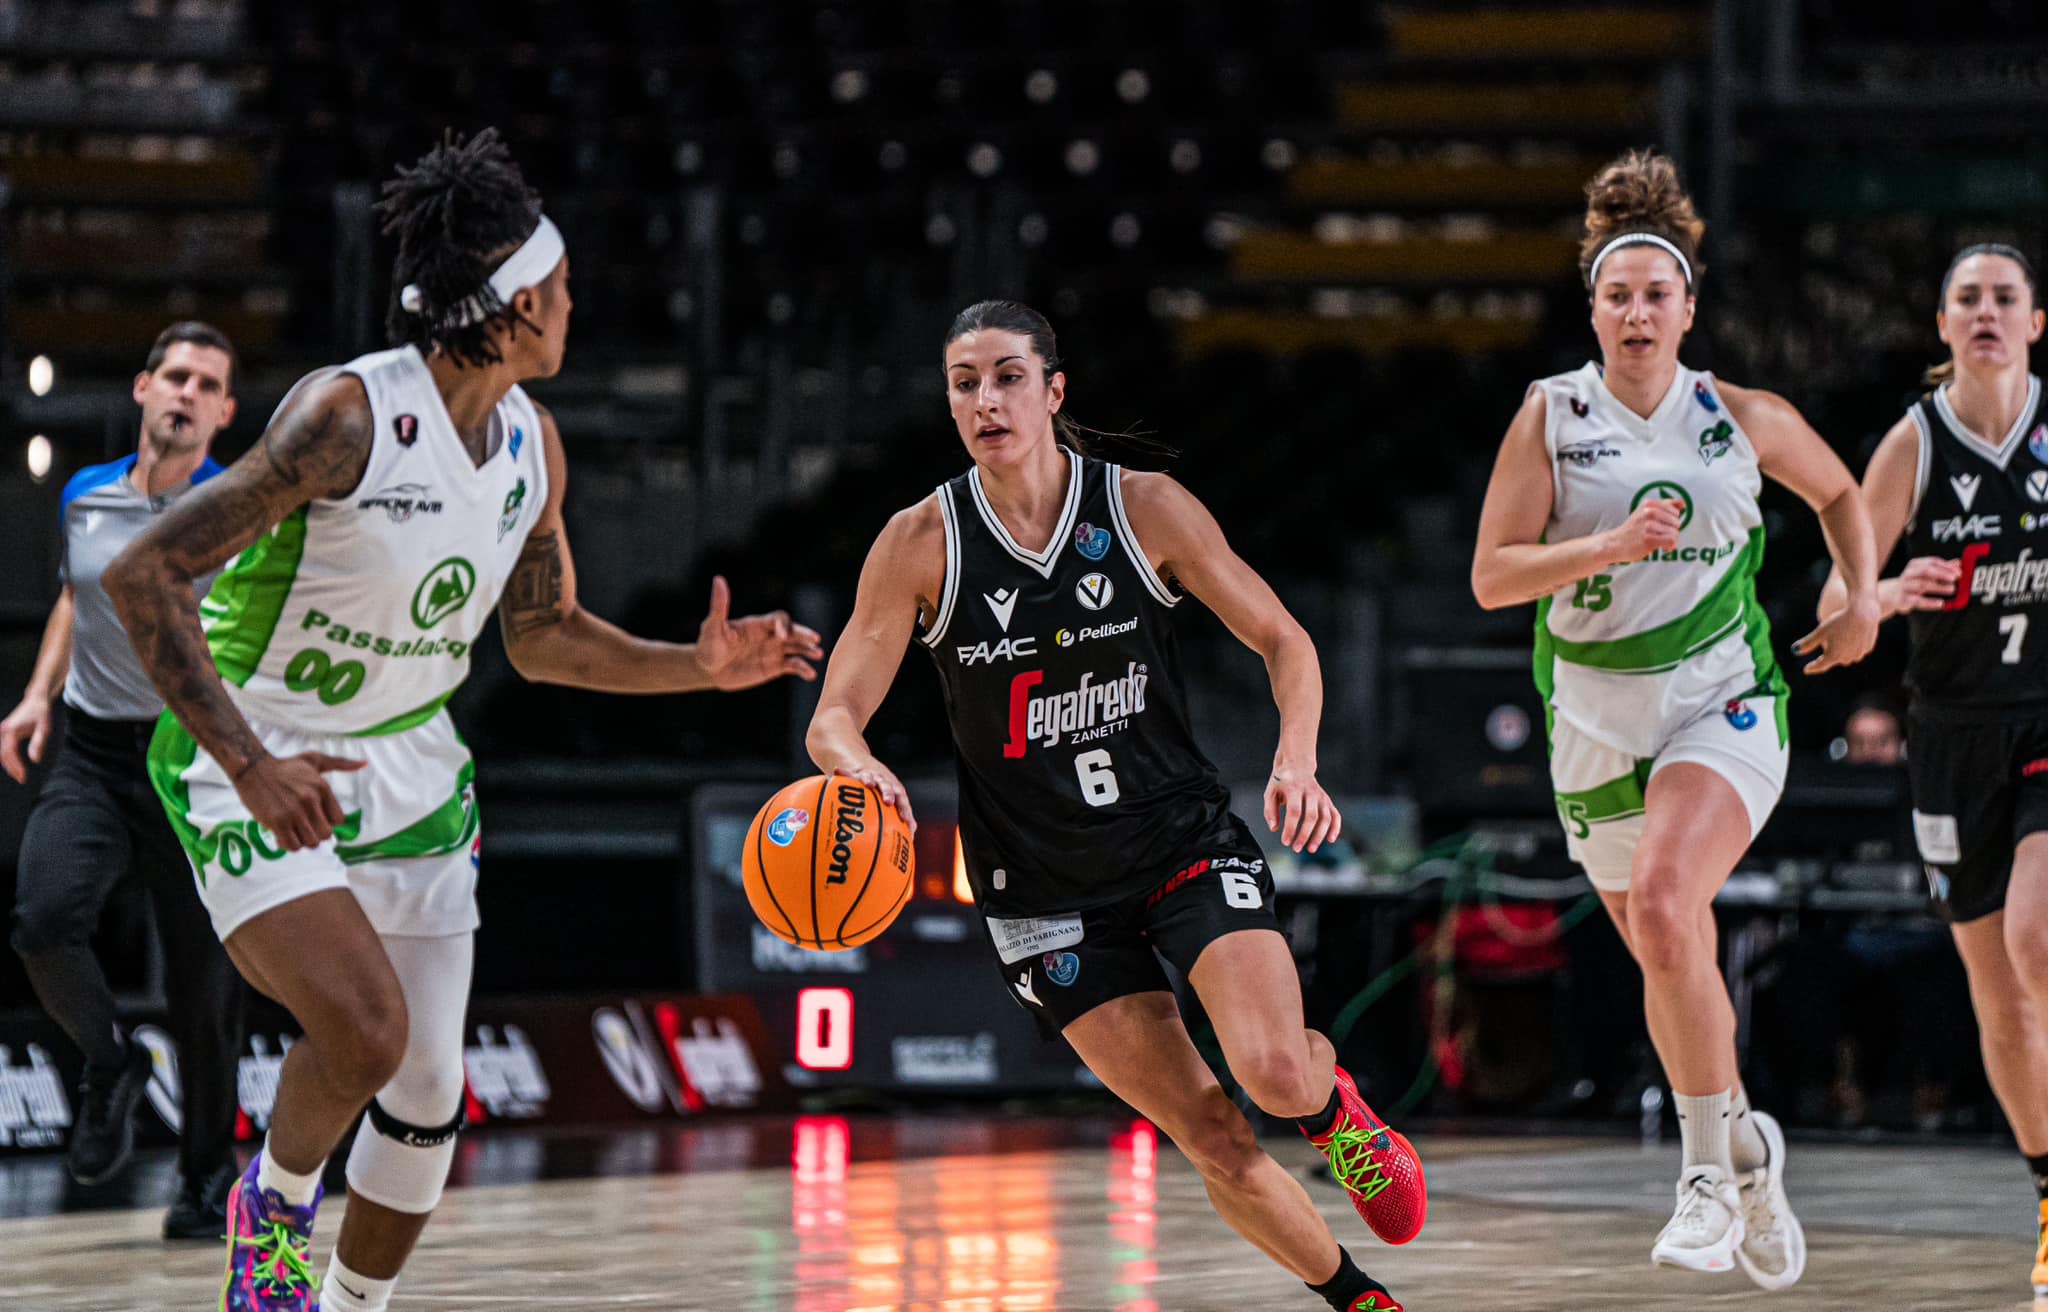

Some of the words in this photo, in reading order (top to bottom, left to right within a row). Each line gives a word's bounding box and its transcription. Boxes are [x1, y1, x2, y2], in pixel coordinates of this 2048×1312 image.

[1932, 514, 2001, 542] FAAC
[1572, 574, 1613, 612] 15
[1079, 617, 1138, 642] Pelliconi
[1999, 613, 2028, 664] 7
[956, 637, 1038, 666] FAAC
[284, 648, 366, 706] 00
[1003, 662, 1148, 759] Segafredo
[1071, 719, 1128, 745] ZANETTI
[1074, 748, 1120, 807] 6
[826, 784, 866, 885] Wilson
[1219, 871, 1263, 910] 6
[1022, 936, 1032, 945] DI
[1032, 925, 1081, 941] VARIGNANA
[797, 988, 853, 1070] 0
